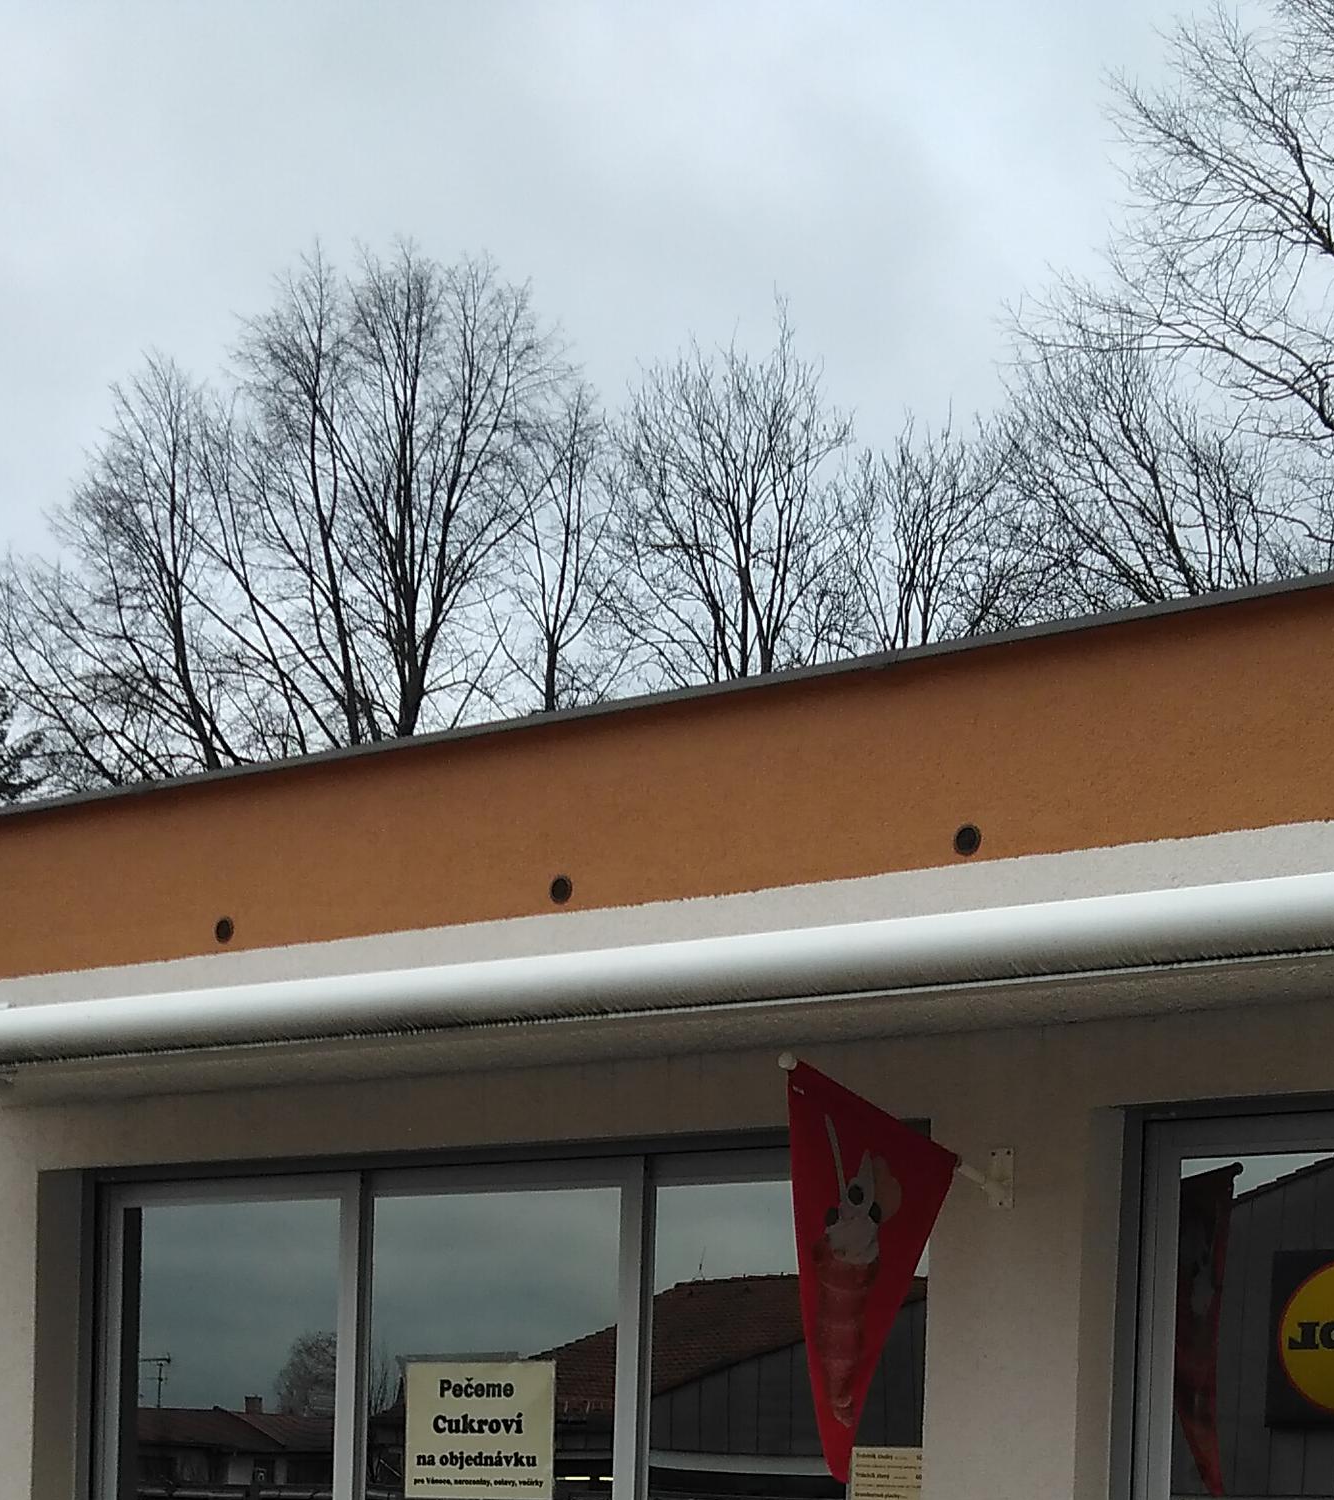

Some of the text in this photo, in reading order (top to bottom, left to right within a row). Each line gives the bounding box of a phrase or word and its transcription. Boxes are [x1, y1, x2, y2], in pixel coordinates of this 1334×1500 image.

[439, 1377, 515, 1398] Pečeme
[433, 1412, 523, 1434] Cukroví
[416, 1451, 537, 1470] na objednávku
